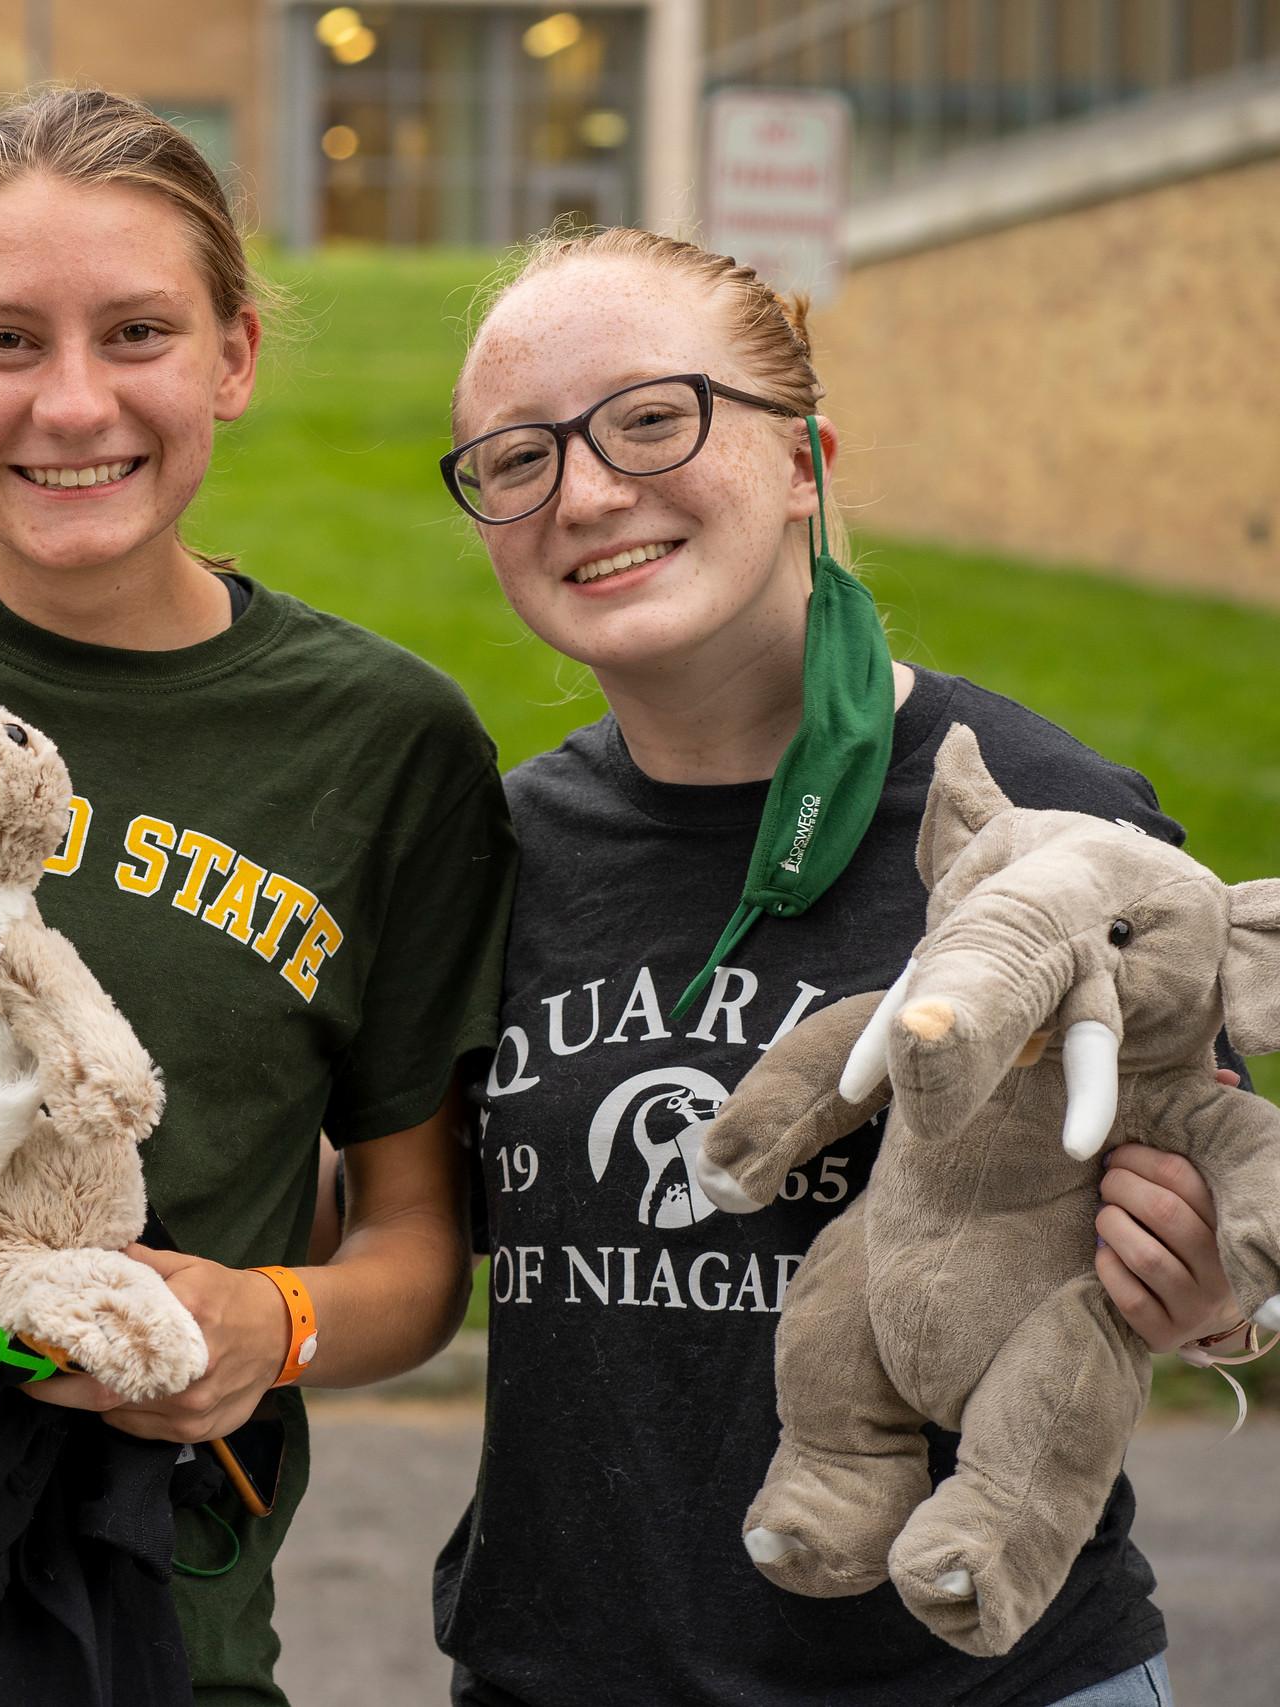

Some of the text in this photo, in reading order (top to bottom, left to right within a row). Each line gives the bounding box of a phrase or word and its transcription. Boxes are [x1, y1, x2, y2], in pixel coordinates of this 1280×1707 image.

[790, 794, 816, 857] OSWEGO
[115, 814, 344, 1004] STATE
[495, 1144, 539, 1193] 19
[493, 1245, 544, 1304] OF
